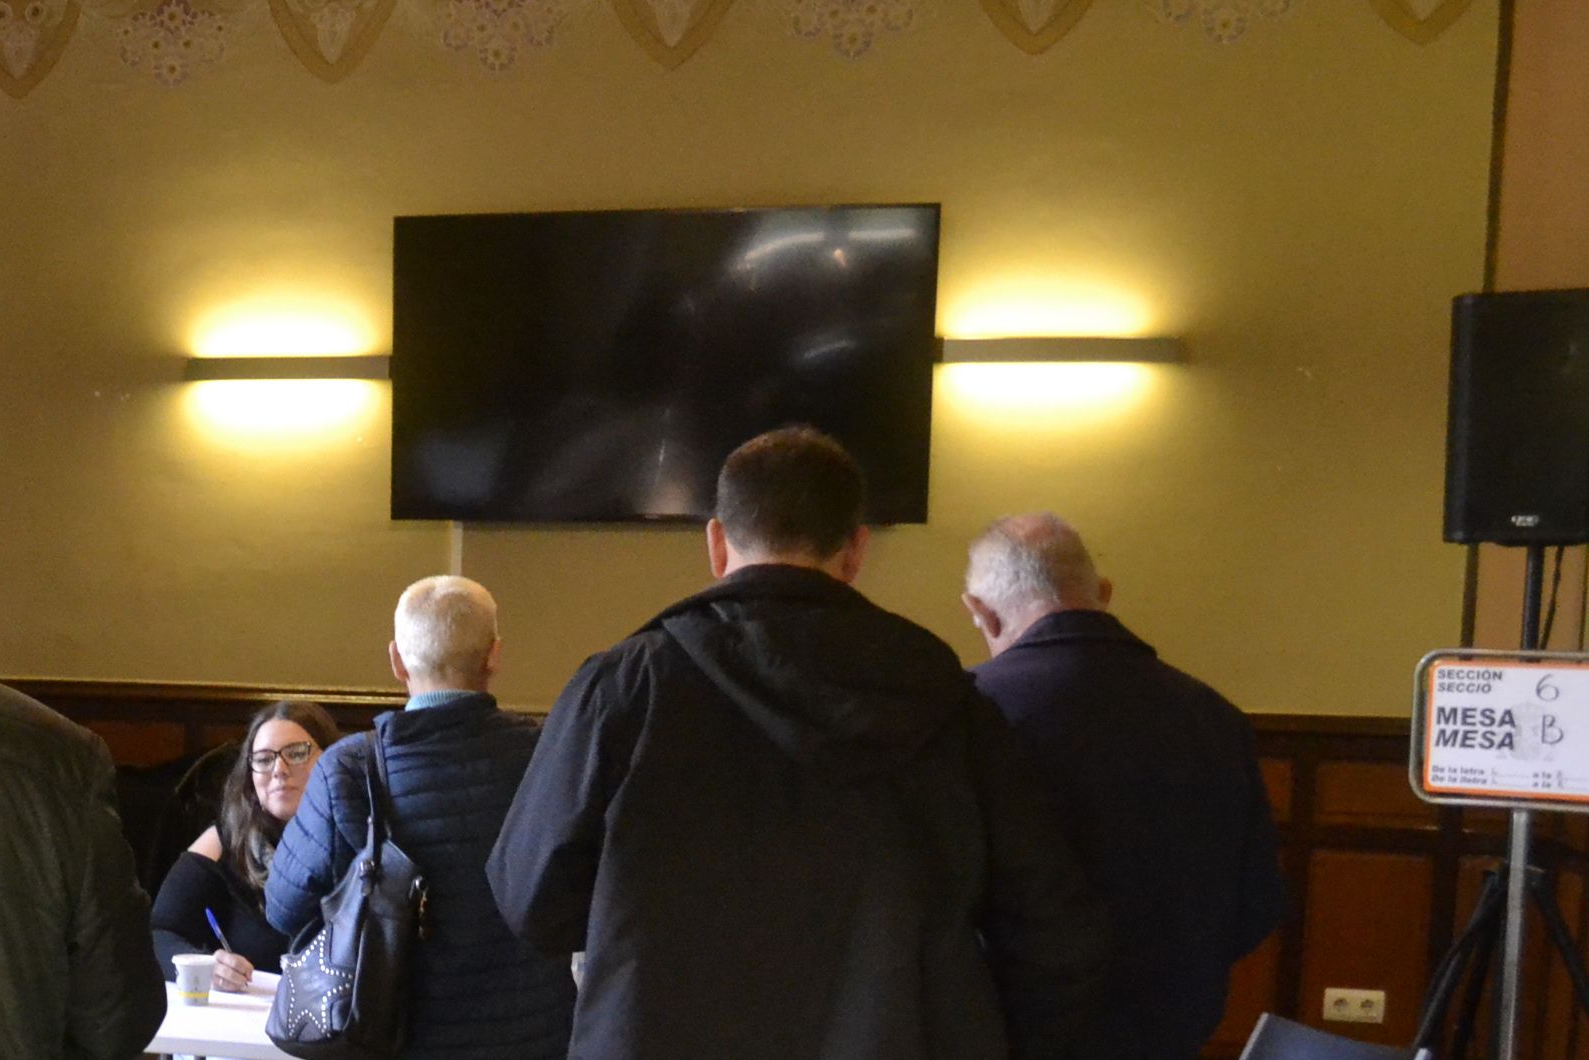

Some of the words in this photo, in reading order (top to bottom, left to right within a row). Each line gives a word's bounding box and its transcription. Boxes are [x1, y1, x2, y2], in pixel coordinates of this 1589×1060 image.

[1535, 674, 1560, 702] 6
[1436, 706, 1517, 729] MESA
[1540, 714, 1564, 745] B
[1435, 728, 1516, 752] MESA
